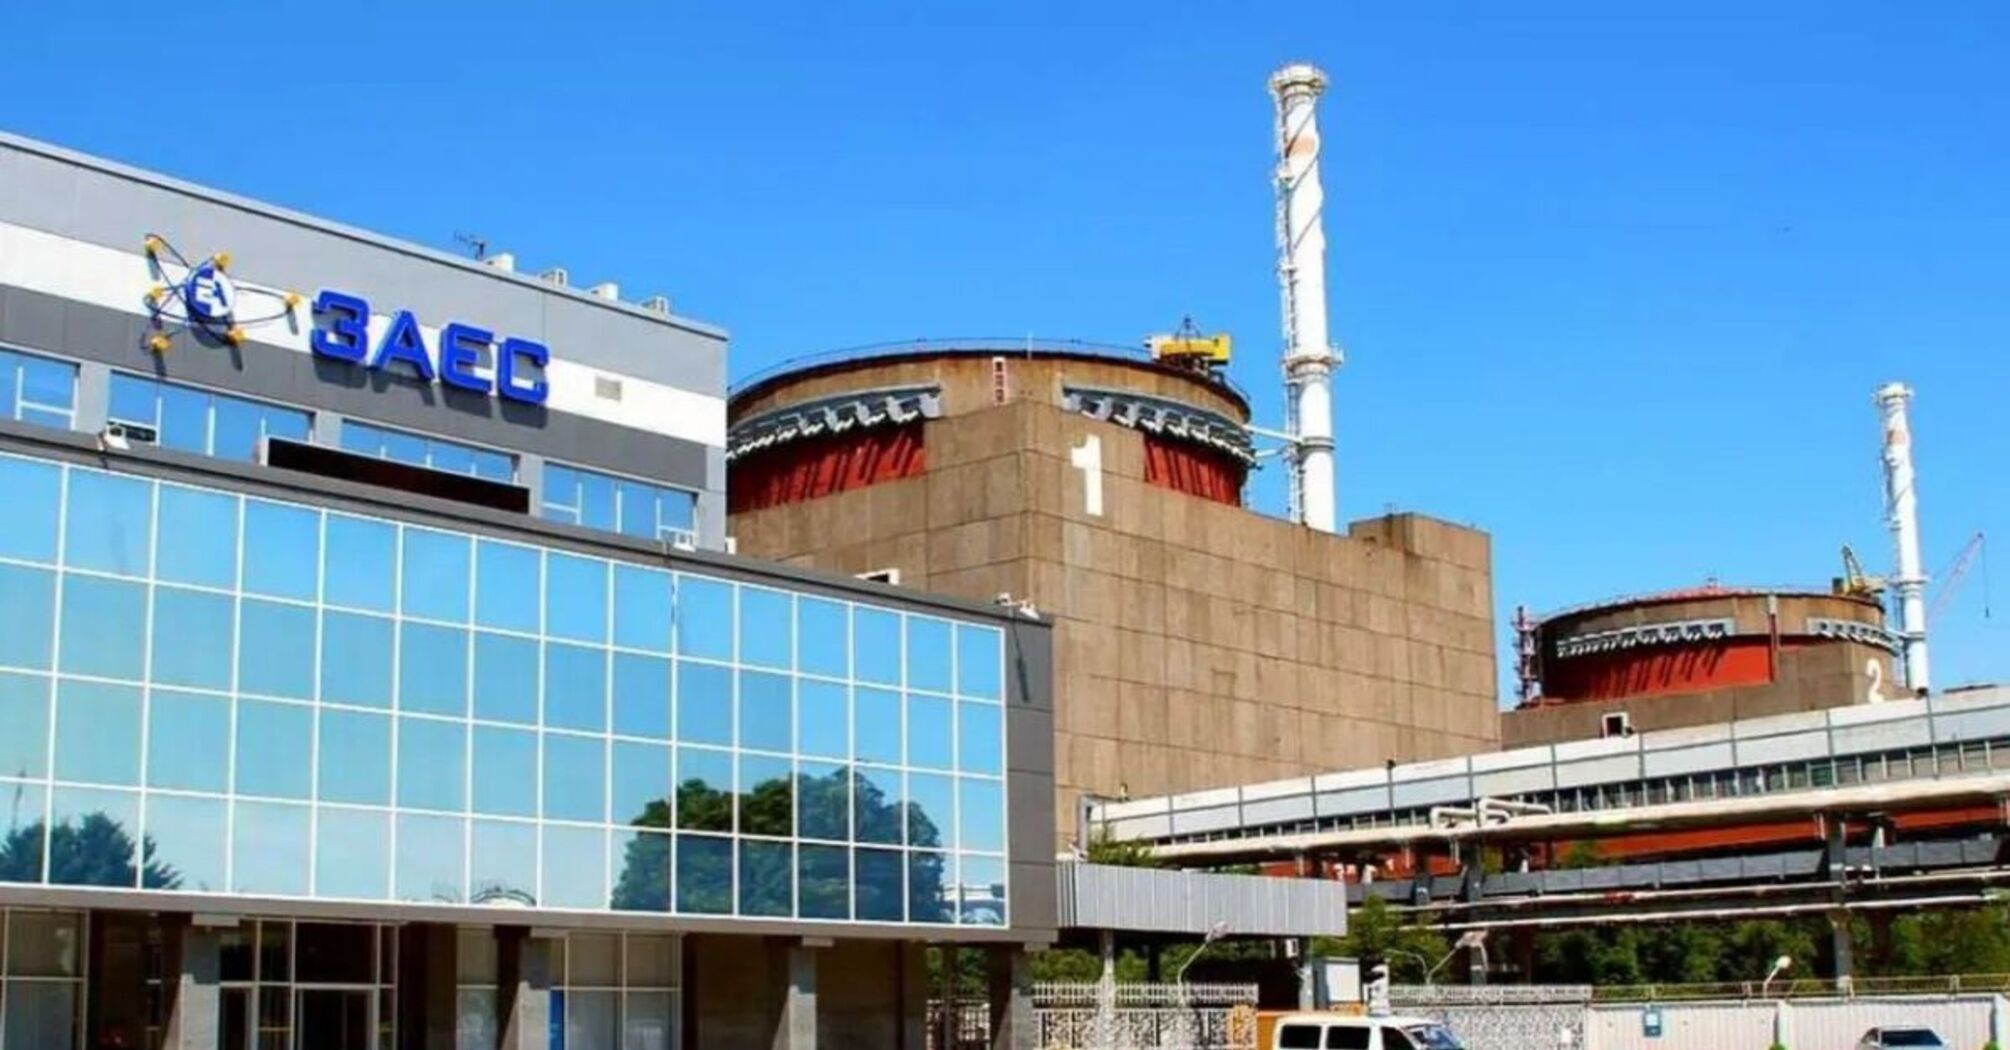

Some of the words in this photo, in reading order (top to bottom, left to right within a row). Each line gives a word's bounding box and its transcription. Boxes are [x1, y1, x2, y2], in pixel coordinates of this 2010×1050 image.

[311, 290, 549, 405] ЗАЕС
[1071, 434, 1103, 516] 1
[1866, 658, 1884, 703] 2
